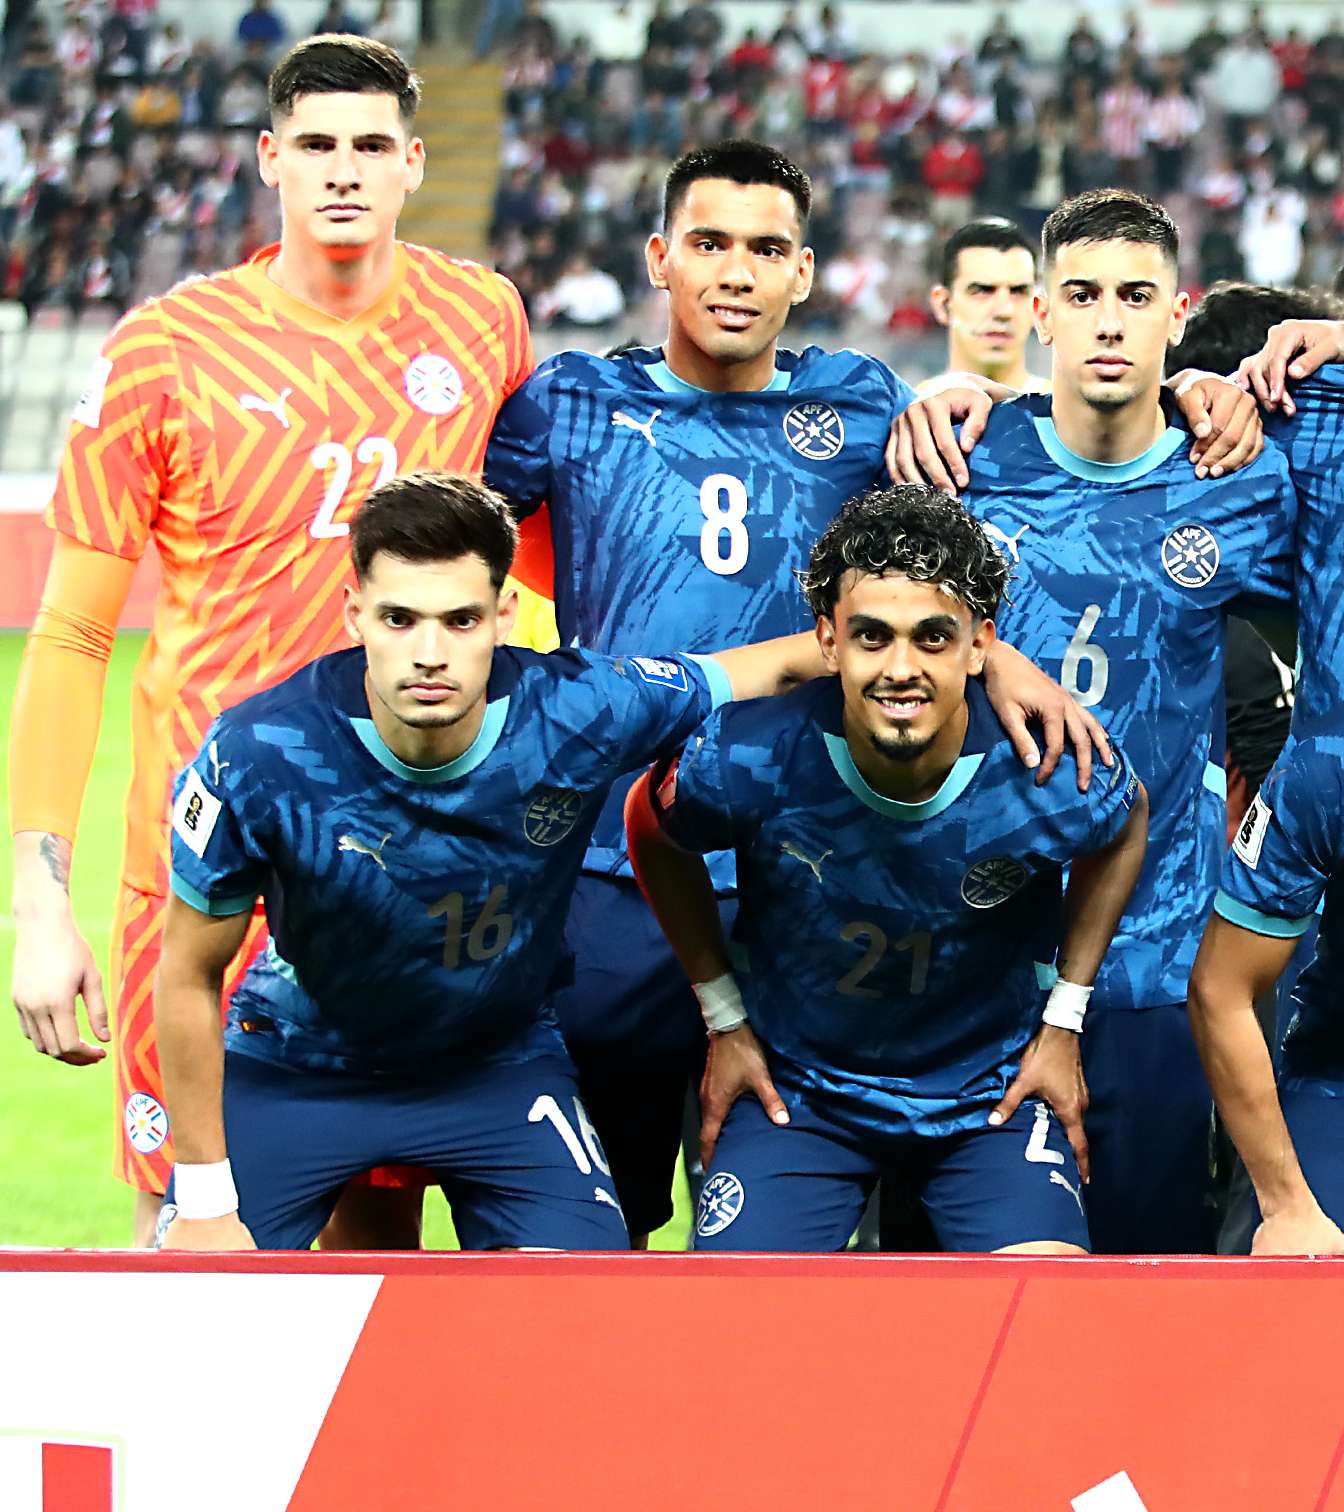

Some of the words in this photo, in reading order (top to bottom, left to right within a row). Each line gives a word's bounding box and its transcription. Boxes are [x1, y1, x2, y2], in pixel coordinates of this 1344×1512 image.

[803, 404, 822, 415] APF
[699, 473, 749, 575] 8
[1182, 528, 1202, 540] APF
[1061, 604, 1109, 706] 6
[427, 884, 513, 968] 16
[835, 921, 932, 998] 21
